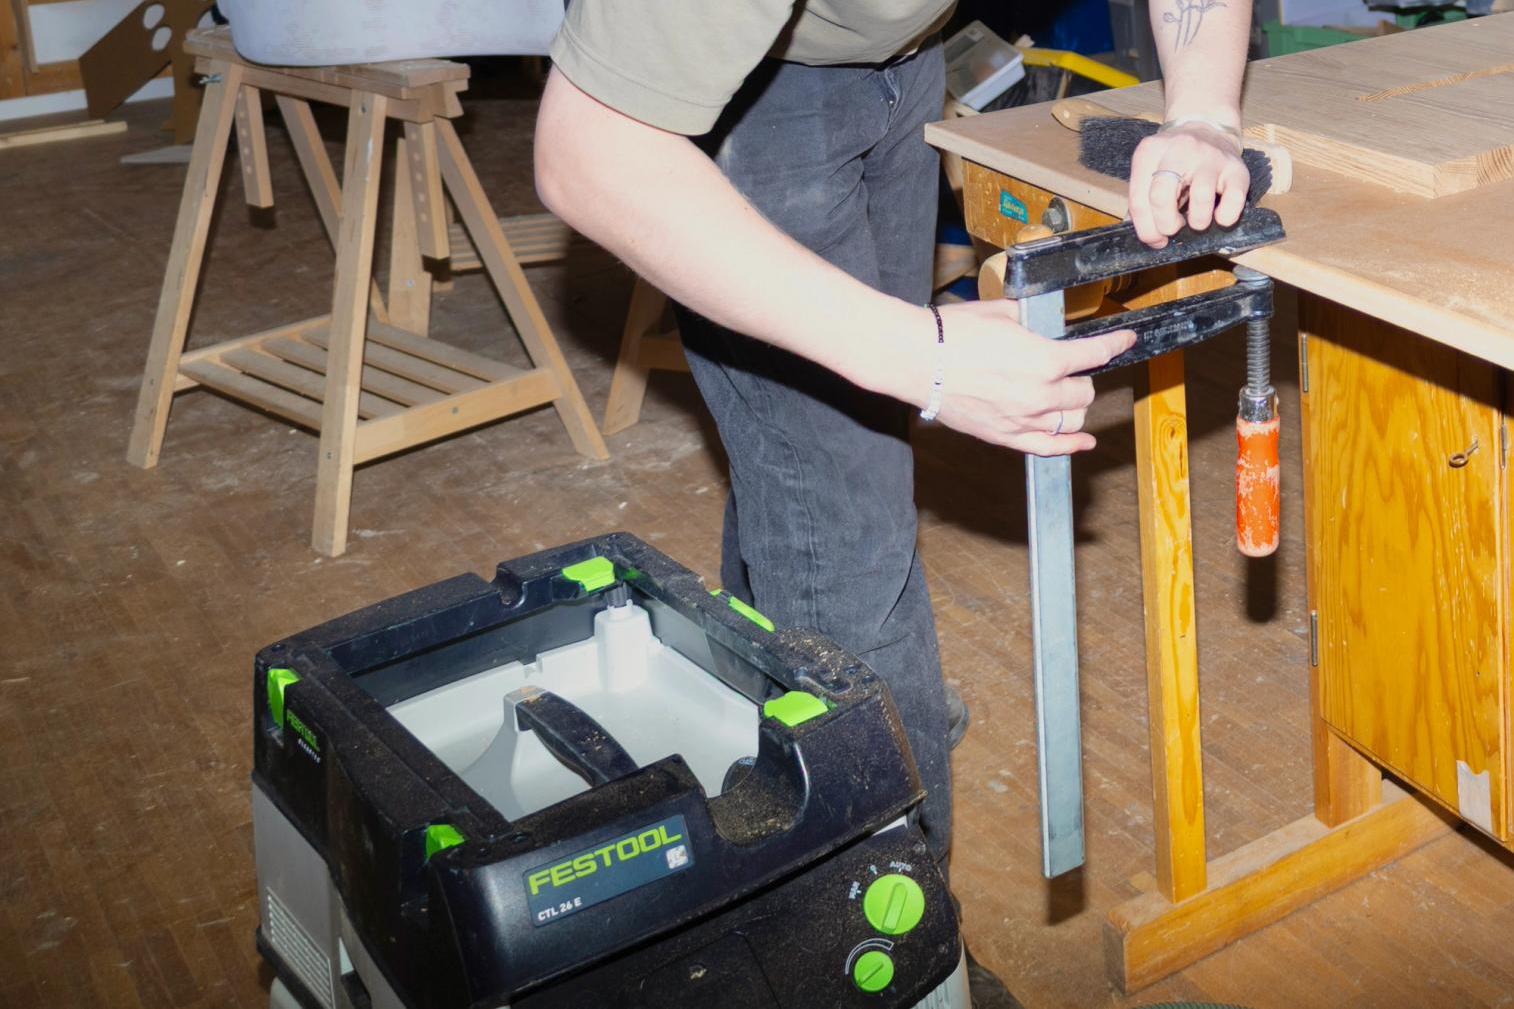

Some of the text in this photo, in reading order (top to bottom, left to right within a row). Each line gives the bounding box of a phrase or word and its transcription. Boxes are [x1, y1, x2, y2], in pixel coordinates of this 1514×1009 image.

[527, 825, 683, 896] FESTOOL
[889, 860, 912, 872] AUTO
[537, 896, 583, 921] CTL 26 E
